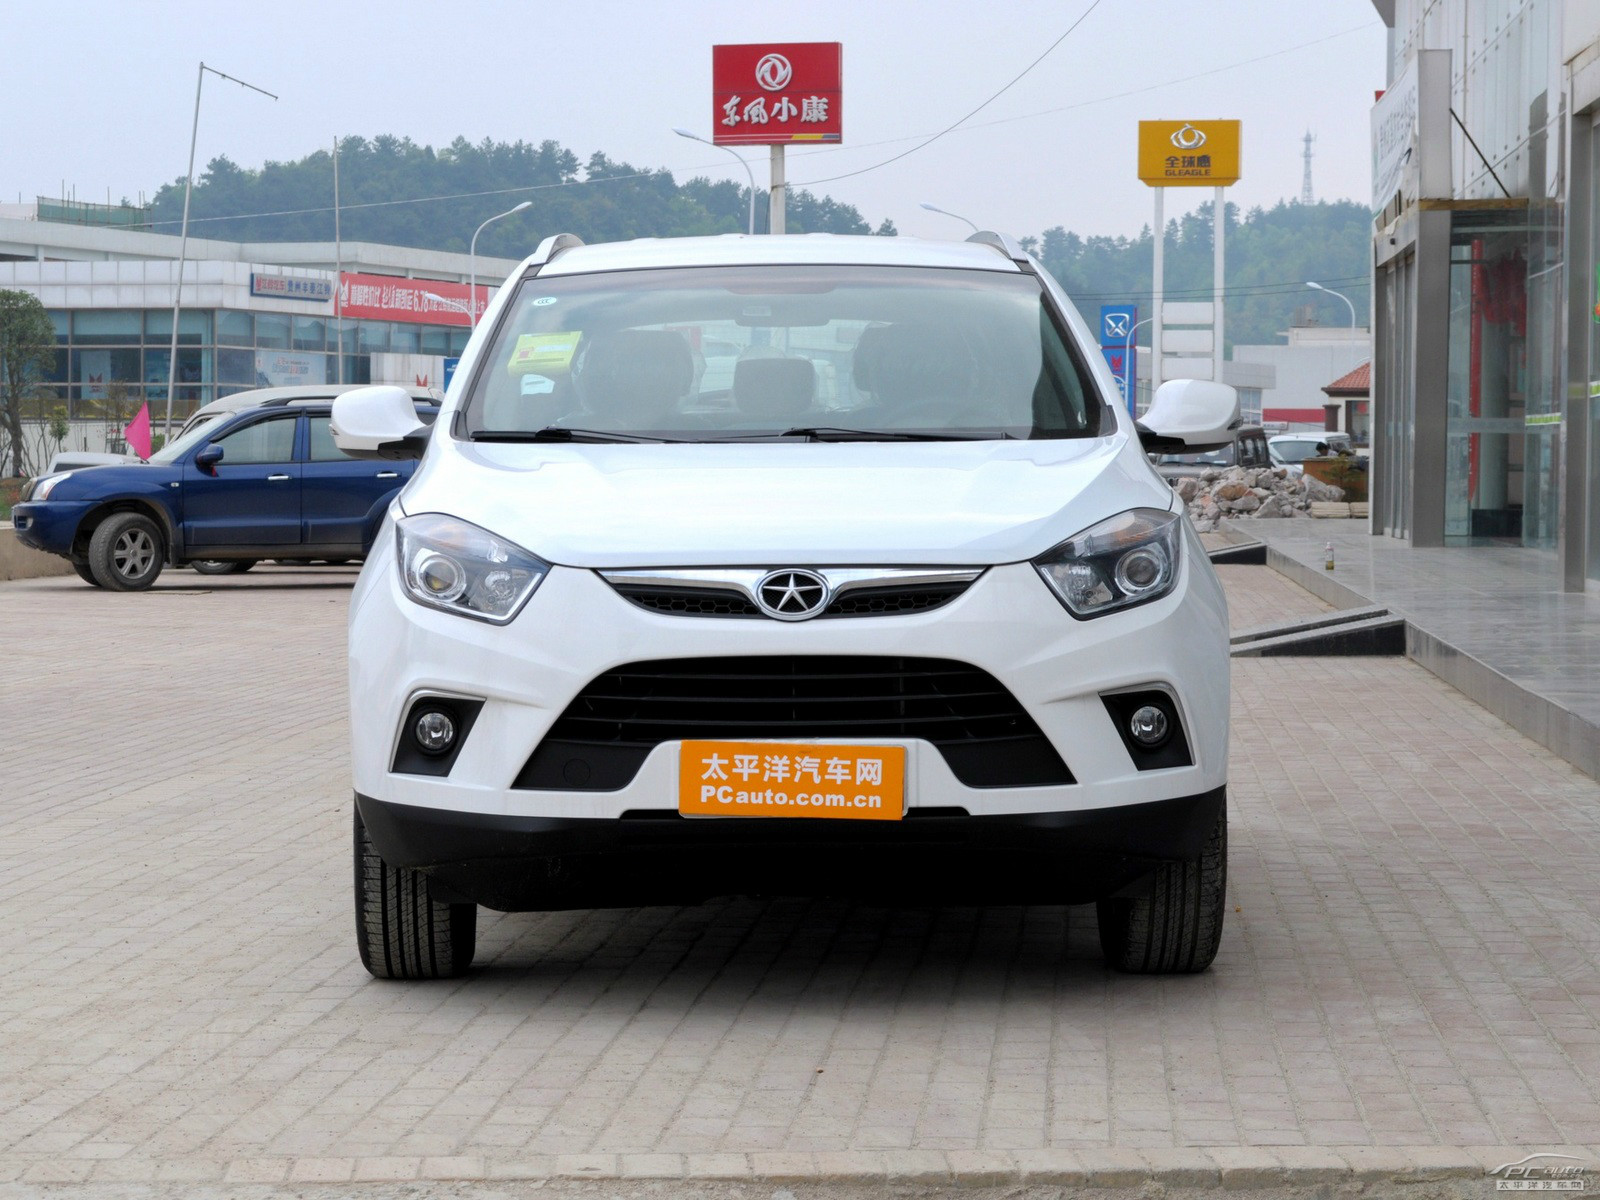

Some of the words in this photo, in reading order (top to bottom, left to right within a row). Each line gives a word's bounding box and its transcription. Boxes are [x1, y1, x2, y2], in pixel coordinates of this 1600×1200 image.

[721, 95, 829, 127] 东风小康
[1165, 154, 1211, 168] 全球鹰
[1165, 169, 1211, 177] GLEAGLE
[700, 752, 883, 786] 太平洋汽车网
[700, 785, 882, 808] PCauto.com.cn
